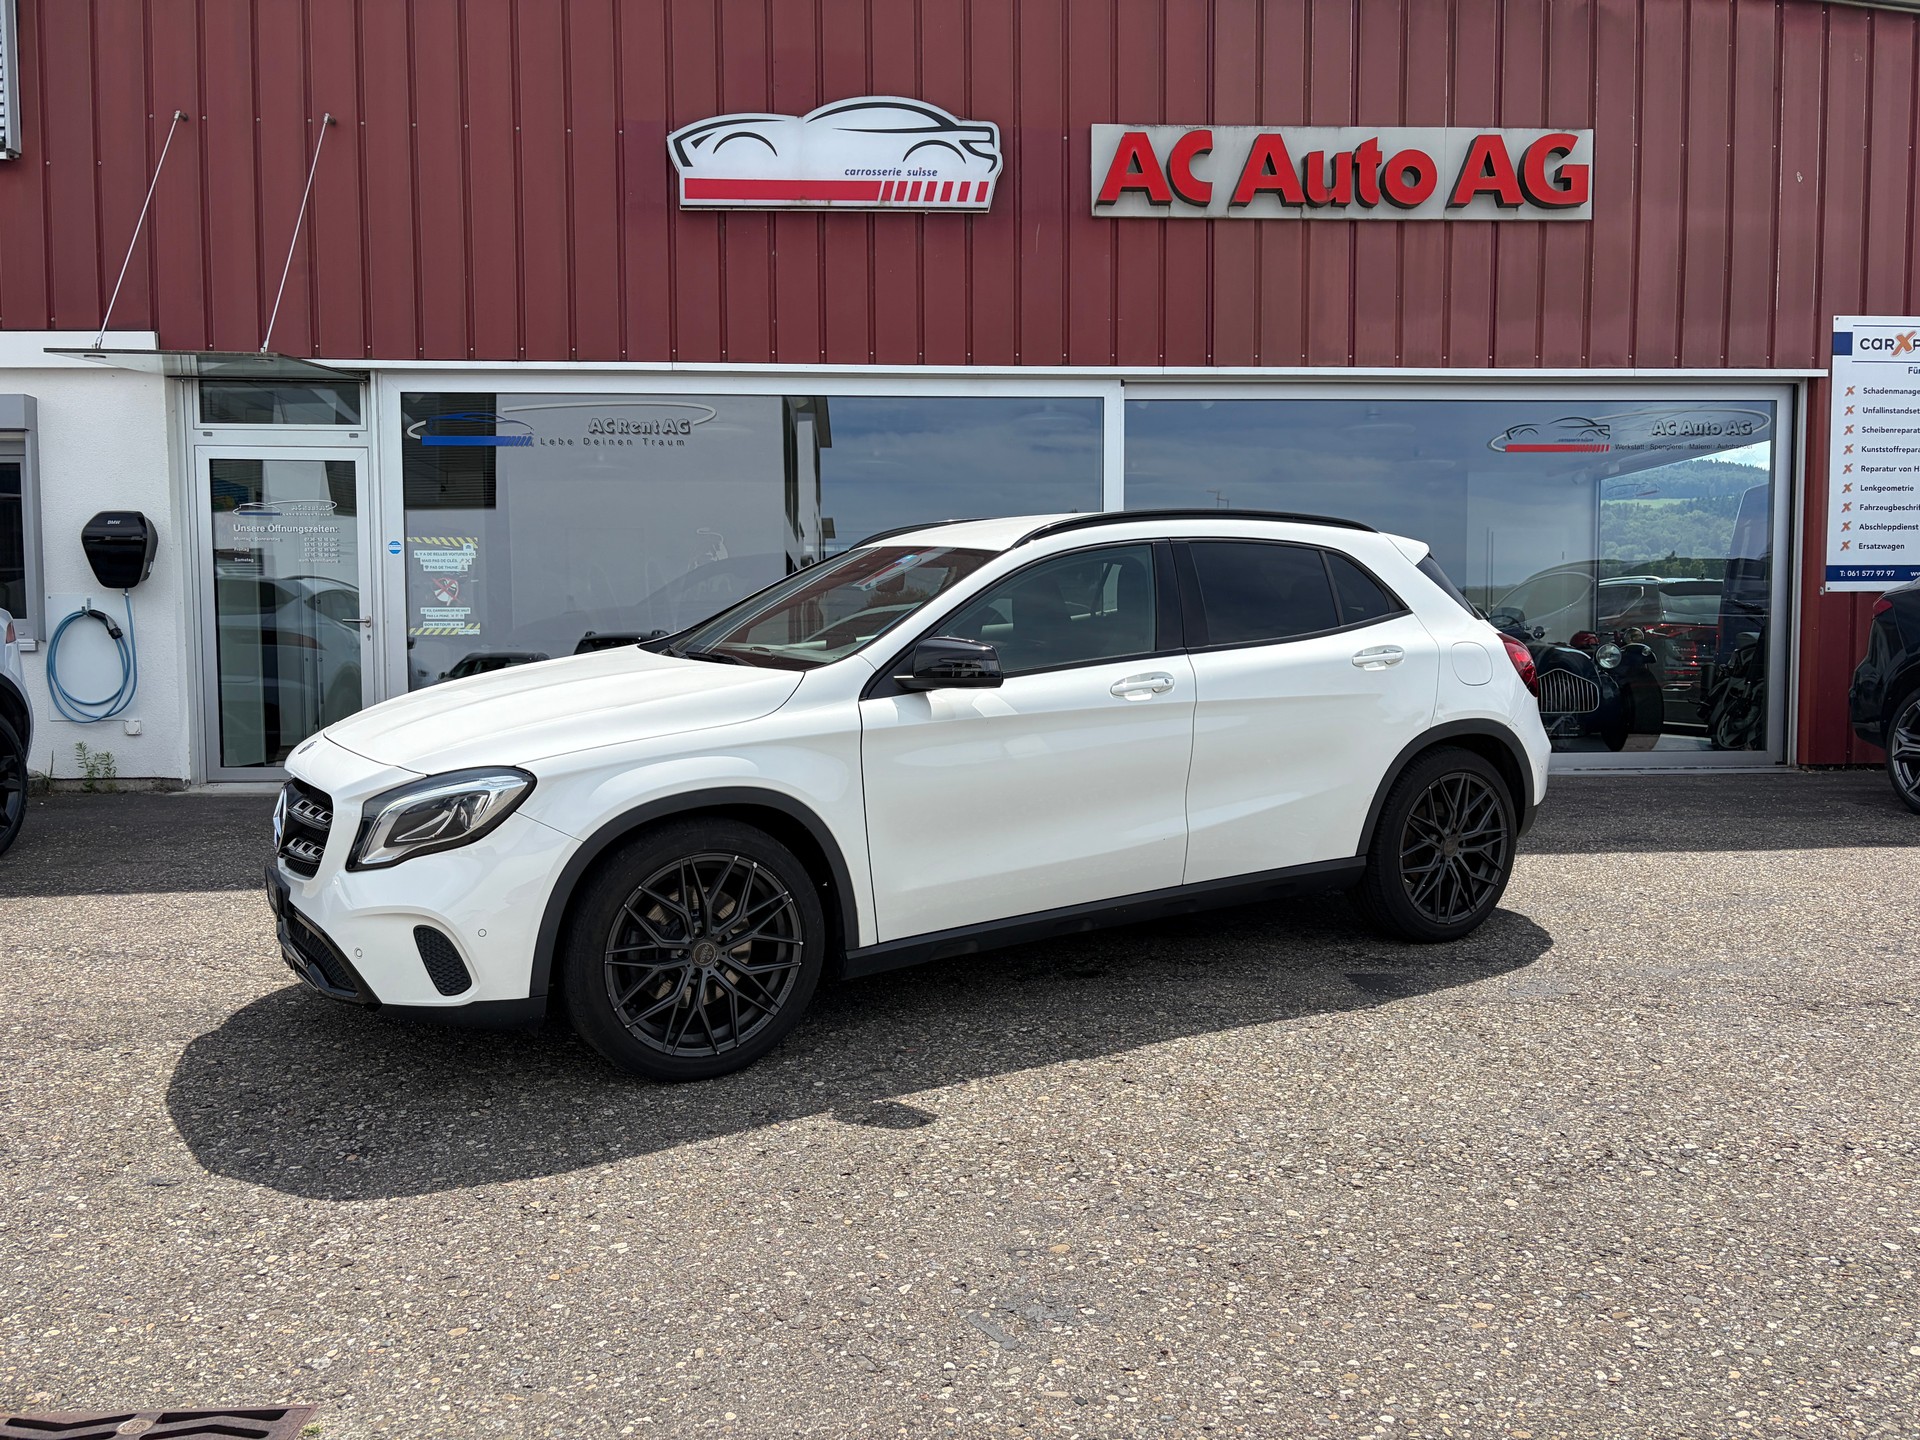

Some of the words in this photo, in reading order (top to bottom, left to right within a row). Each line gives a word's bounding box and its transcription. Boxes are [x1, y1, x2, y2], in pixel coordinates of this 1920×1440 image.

[844, 167, 902, 176] carrosserie
[907, 167, 938, 177] suisse
[1097, 130, 1212, 206] AC
[1229, 133, 1438, 209] Auto
[1447, 134, 1589, 209] AG
[1652, 420, 1677, 436] AC
[1680, 420, 1723, 436] Auto
[1726, 420, 1754, 436] AG
[540, 437, 574, 447] Lebe
[583, 437, 633, 446] Deinen
[642, 437, 686, 447] Traum
[1860, 465, 1897, 473] Reparatur
[1860, 485, 1914, 493] Lenkgeometrie
[233, 524, 266, 532] Unsere
[267, 523, 338, 534] Öffnungszeiten:
[1859, 523, 1919, 532] Abschleppdienst
[1858, 542, 1905, 551] Ersatzwagen
